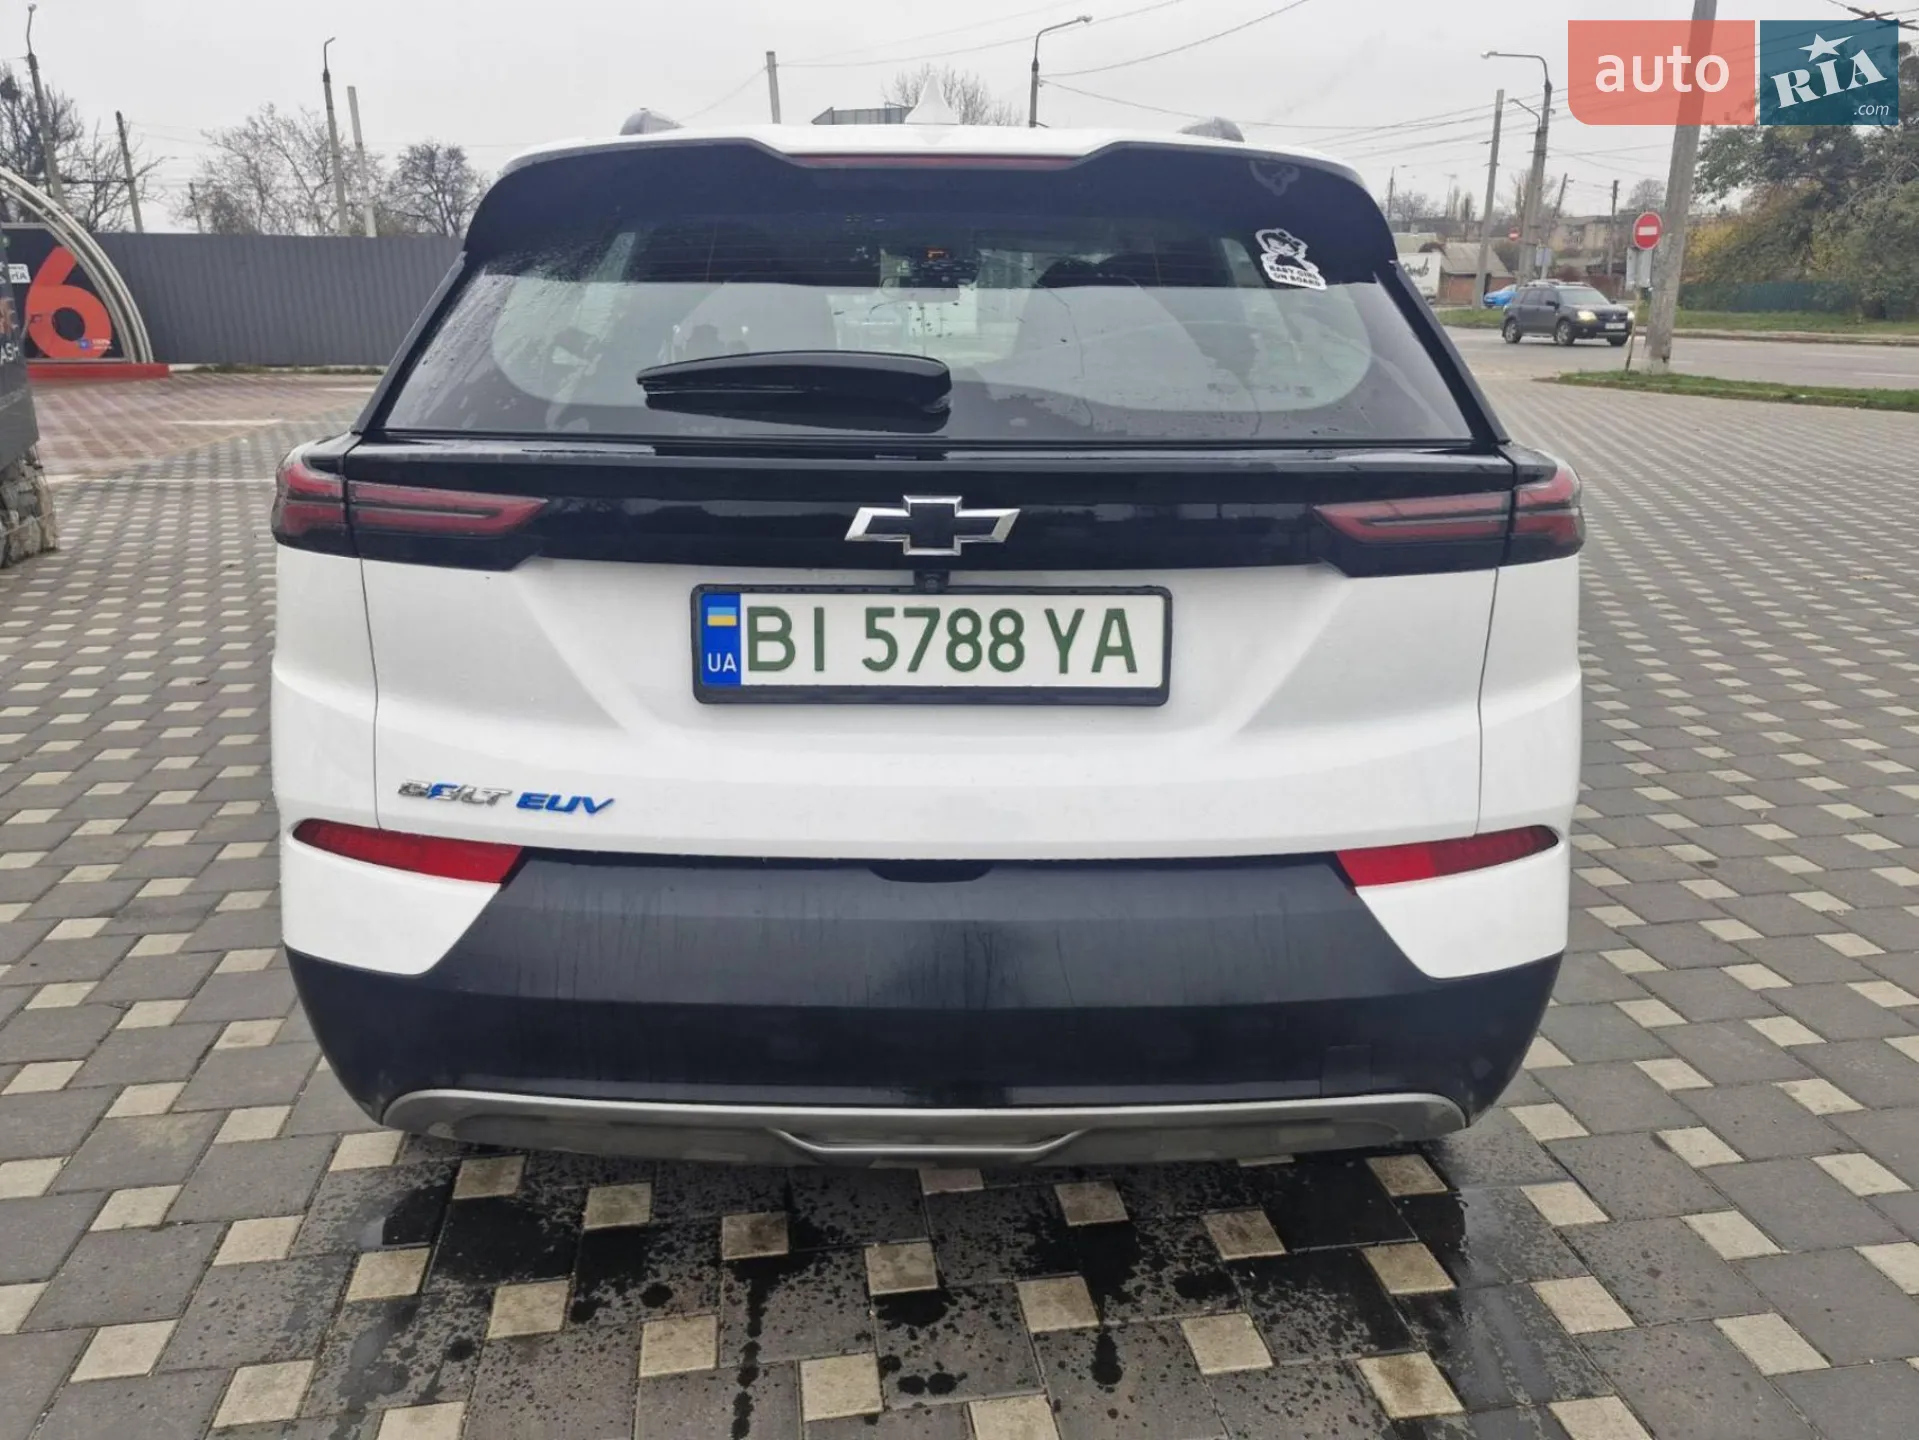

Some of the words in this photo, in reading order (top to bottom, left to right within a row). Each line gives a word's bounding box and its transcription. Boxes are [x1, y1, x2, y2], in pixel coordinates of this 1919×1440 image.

[747, 606, 826, 673] BI
[861, 606, 1026, 673] 5788
[1044, 607, 1138, 674] YA
[707, 652, 737, 673] UA
[515, 791, 616, 814] EUV
